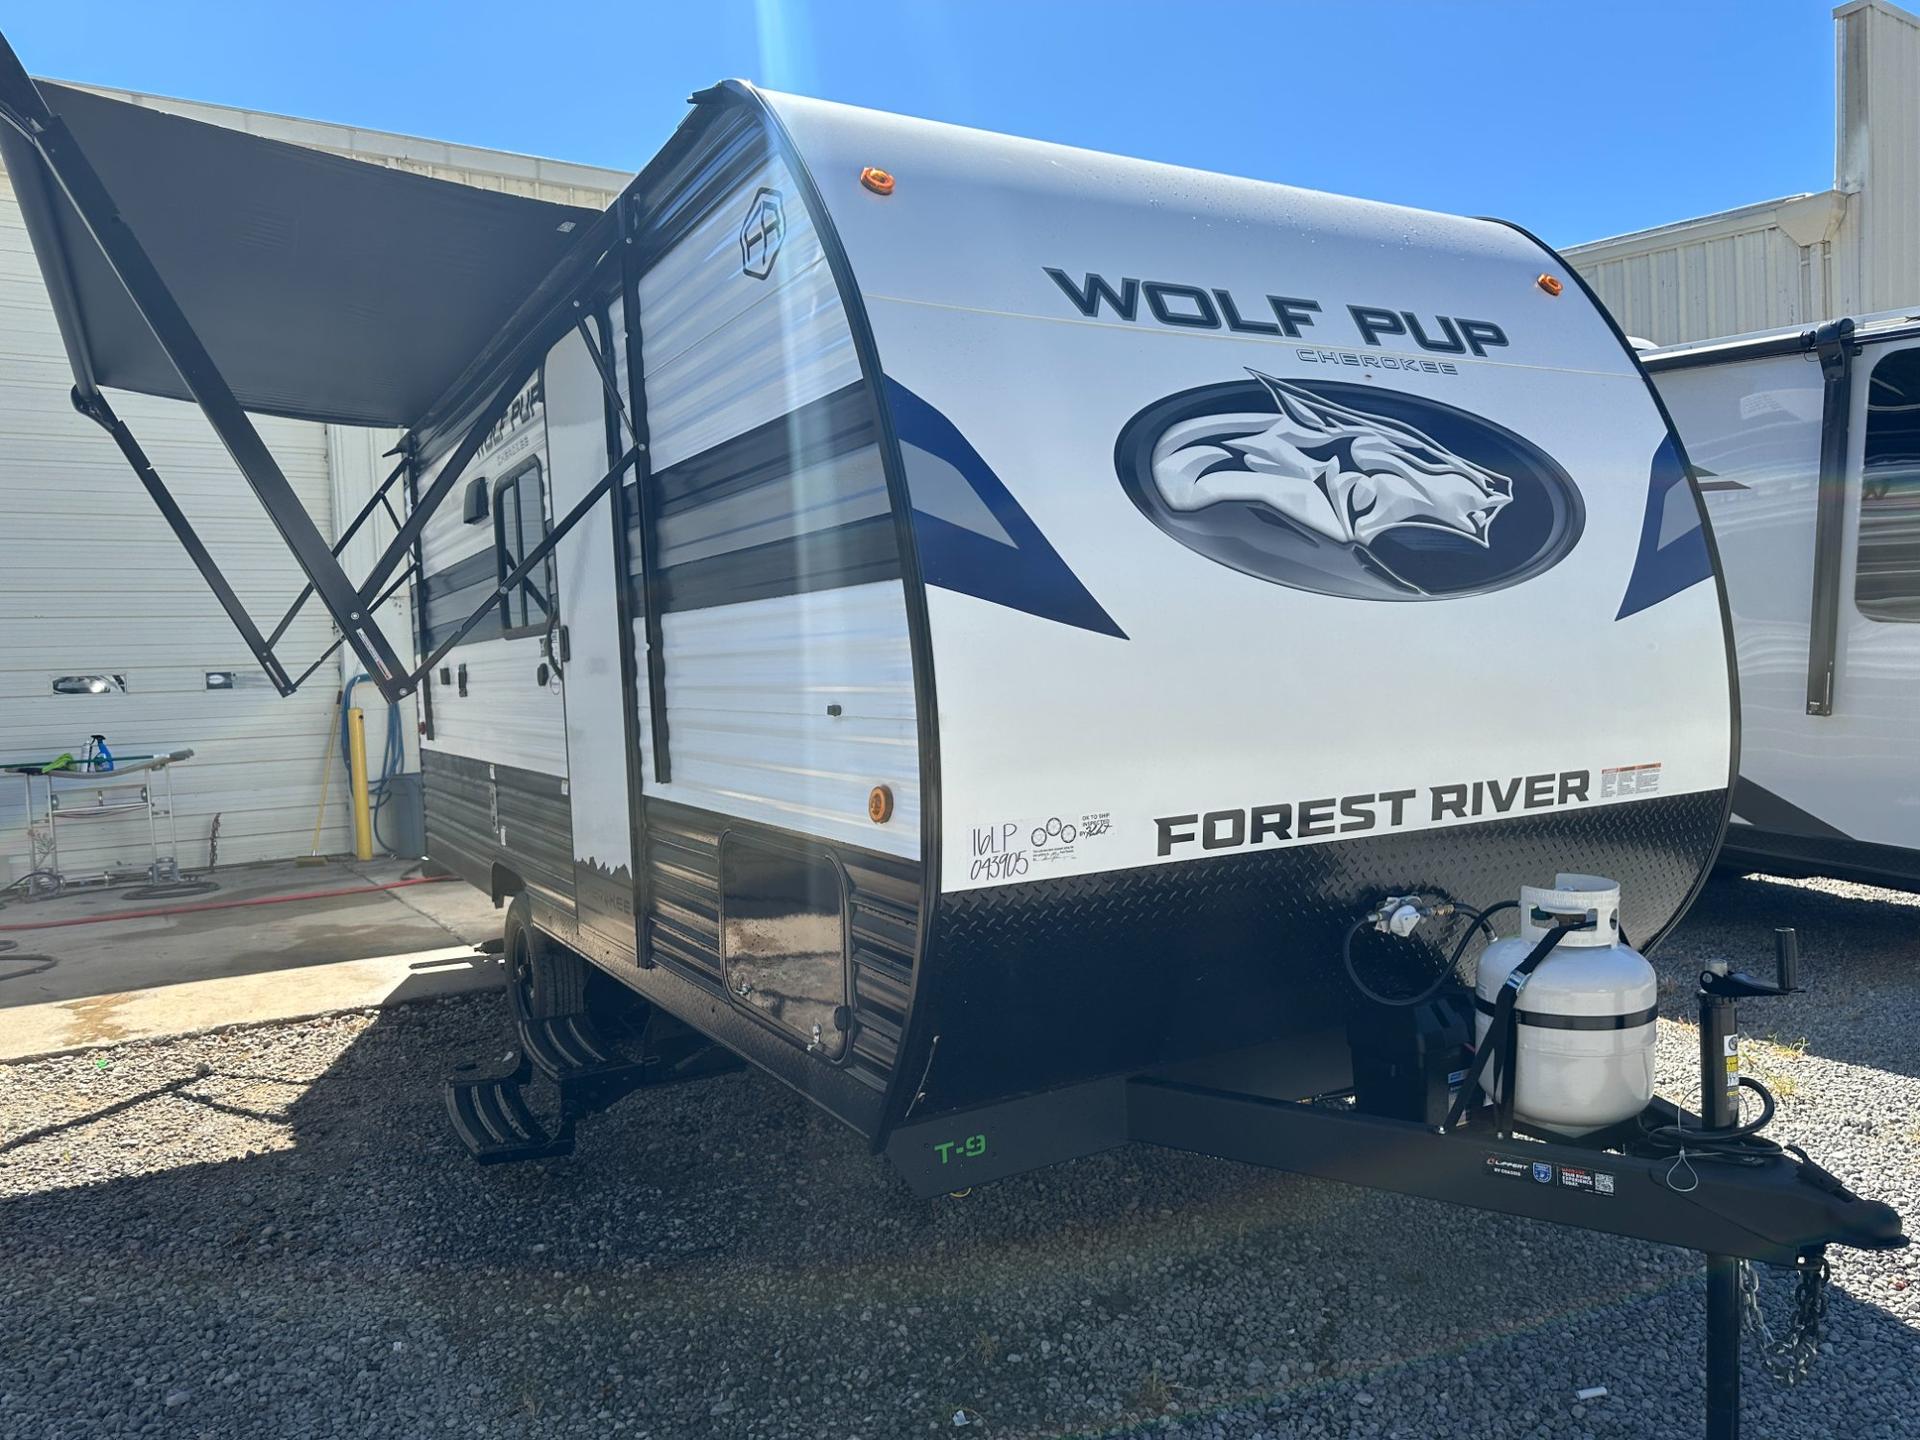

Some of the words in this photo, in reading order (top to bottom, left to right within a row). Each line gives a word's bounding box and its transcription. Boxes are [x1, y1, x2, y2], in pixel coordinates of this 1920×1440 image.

[1042, 266, 1323, 338] WOLF
[1346, 304, 1509, 357] PUP
[1296, 348, 1459, 376] CHEROKEE
[1153, 788, 1417, 857] FOREST
[1428, 769, 1590, 821] RIVER
[933, 1134, 986, 1164] T-9
[1561, 1175, 1593, 1186] EXPERIENCE
